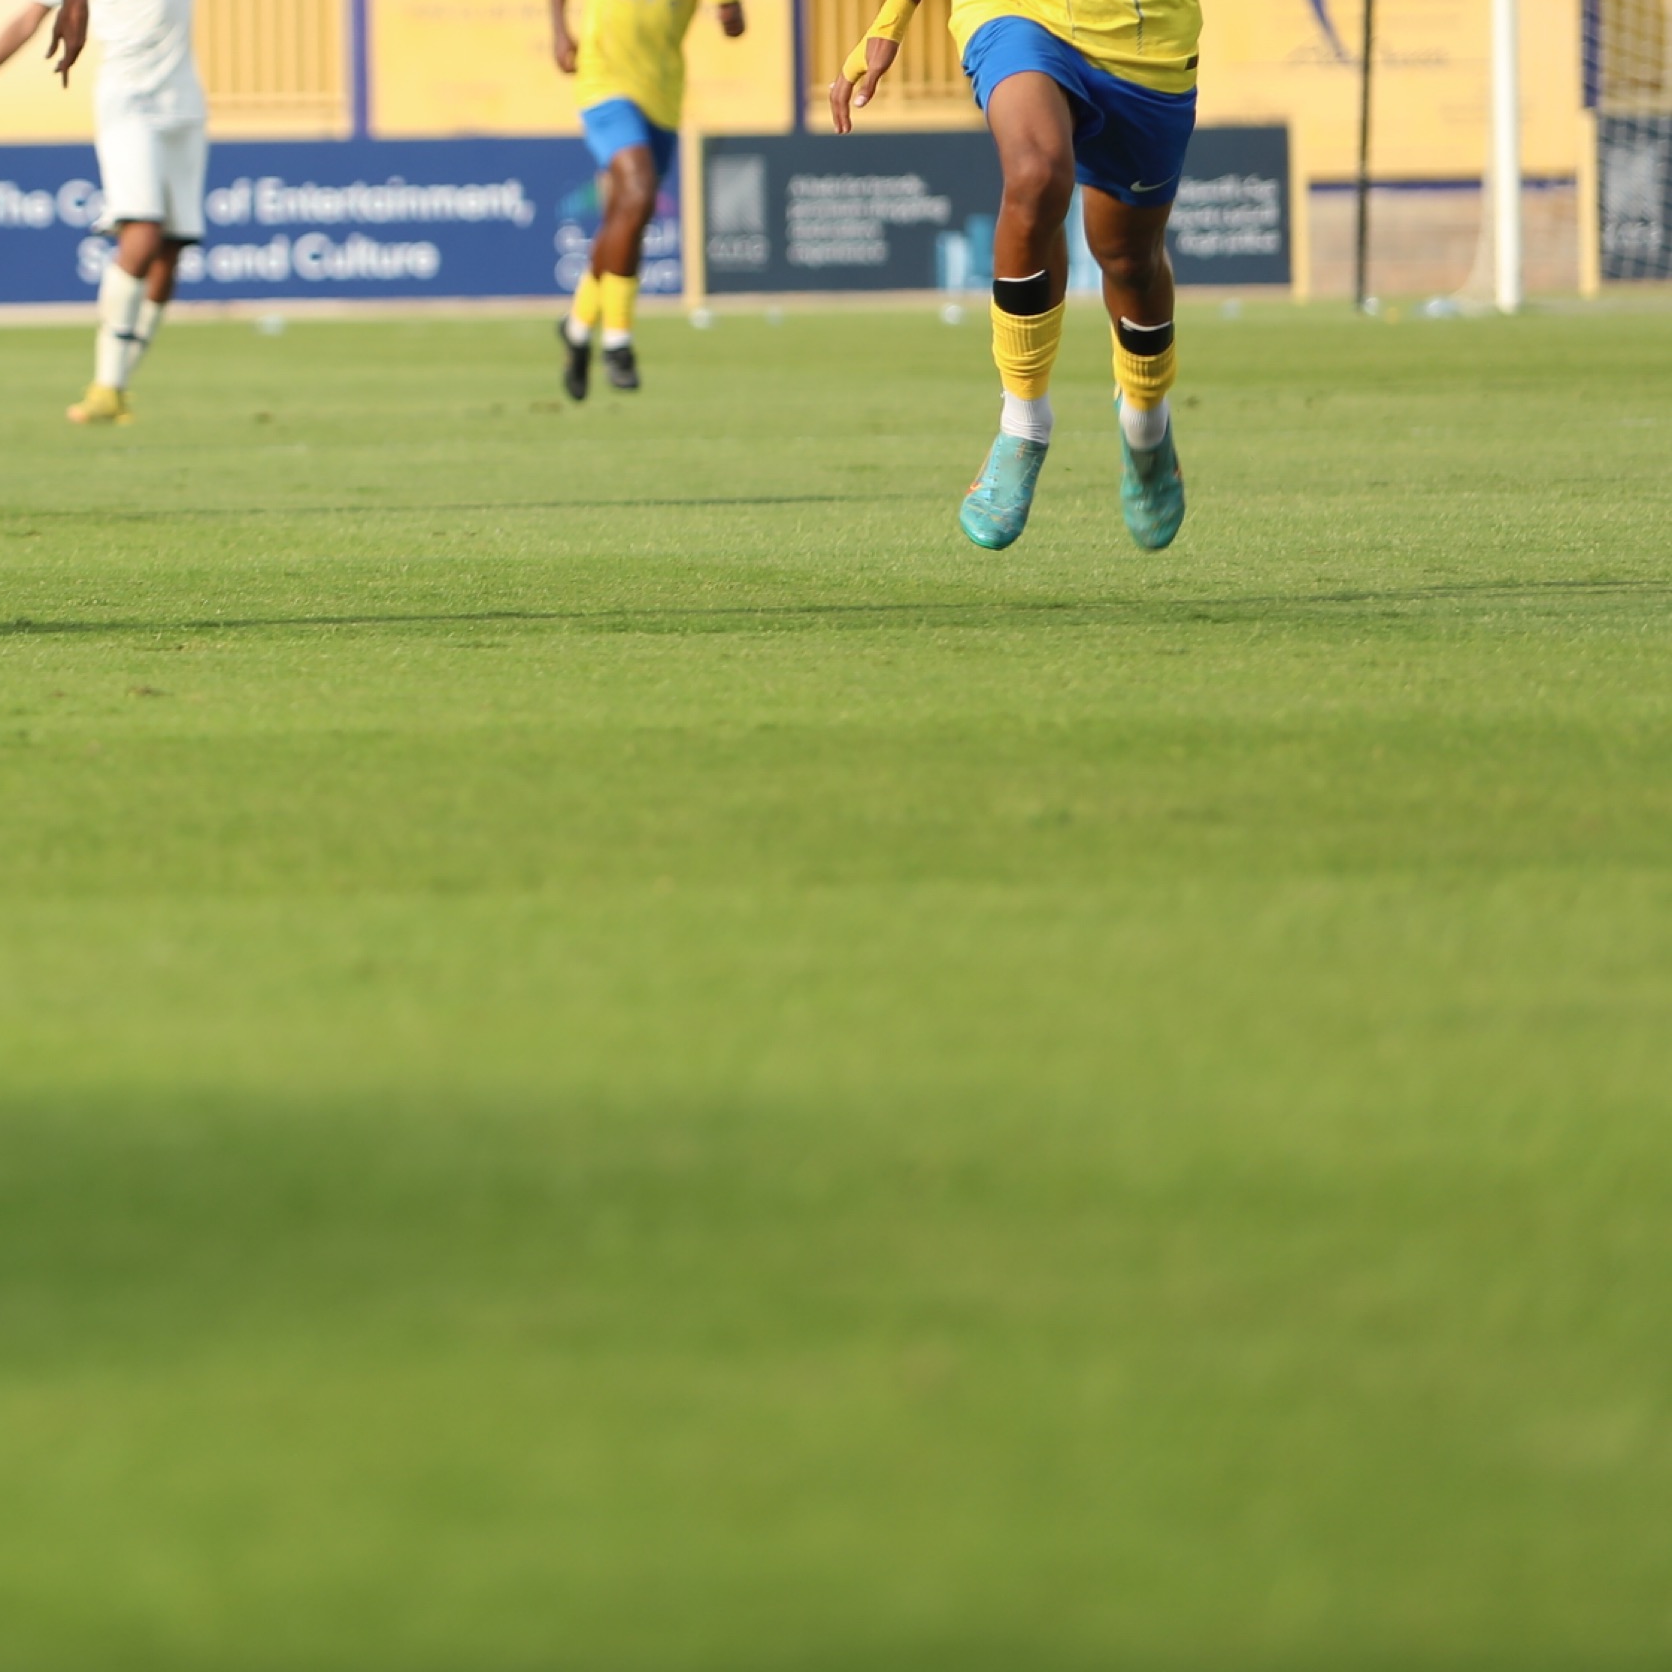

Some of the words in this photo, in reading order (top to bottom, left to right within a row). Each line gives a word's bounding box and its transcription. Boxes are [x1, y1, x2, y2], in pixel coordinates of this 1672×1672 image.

[205, 177, 253, 225] of
[256, 175, 535, 226] Entertainment,
[205, 233, 290, 281] and
[293, 231, 440, 279] Culture
